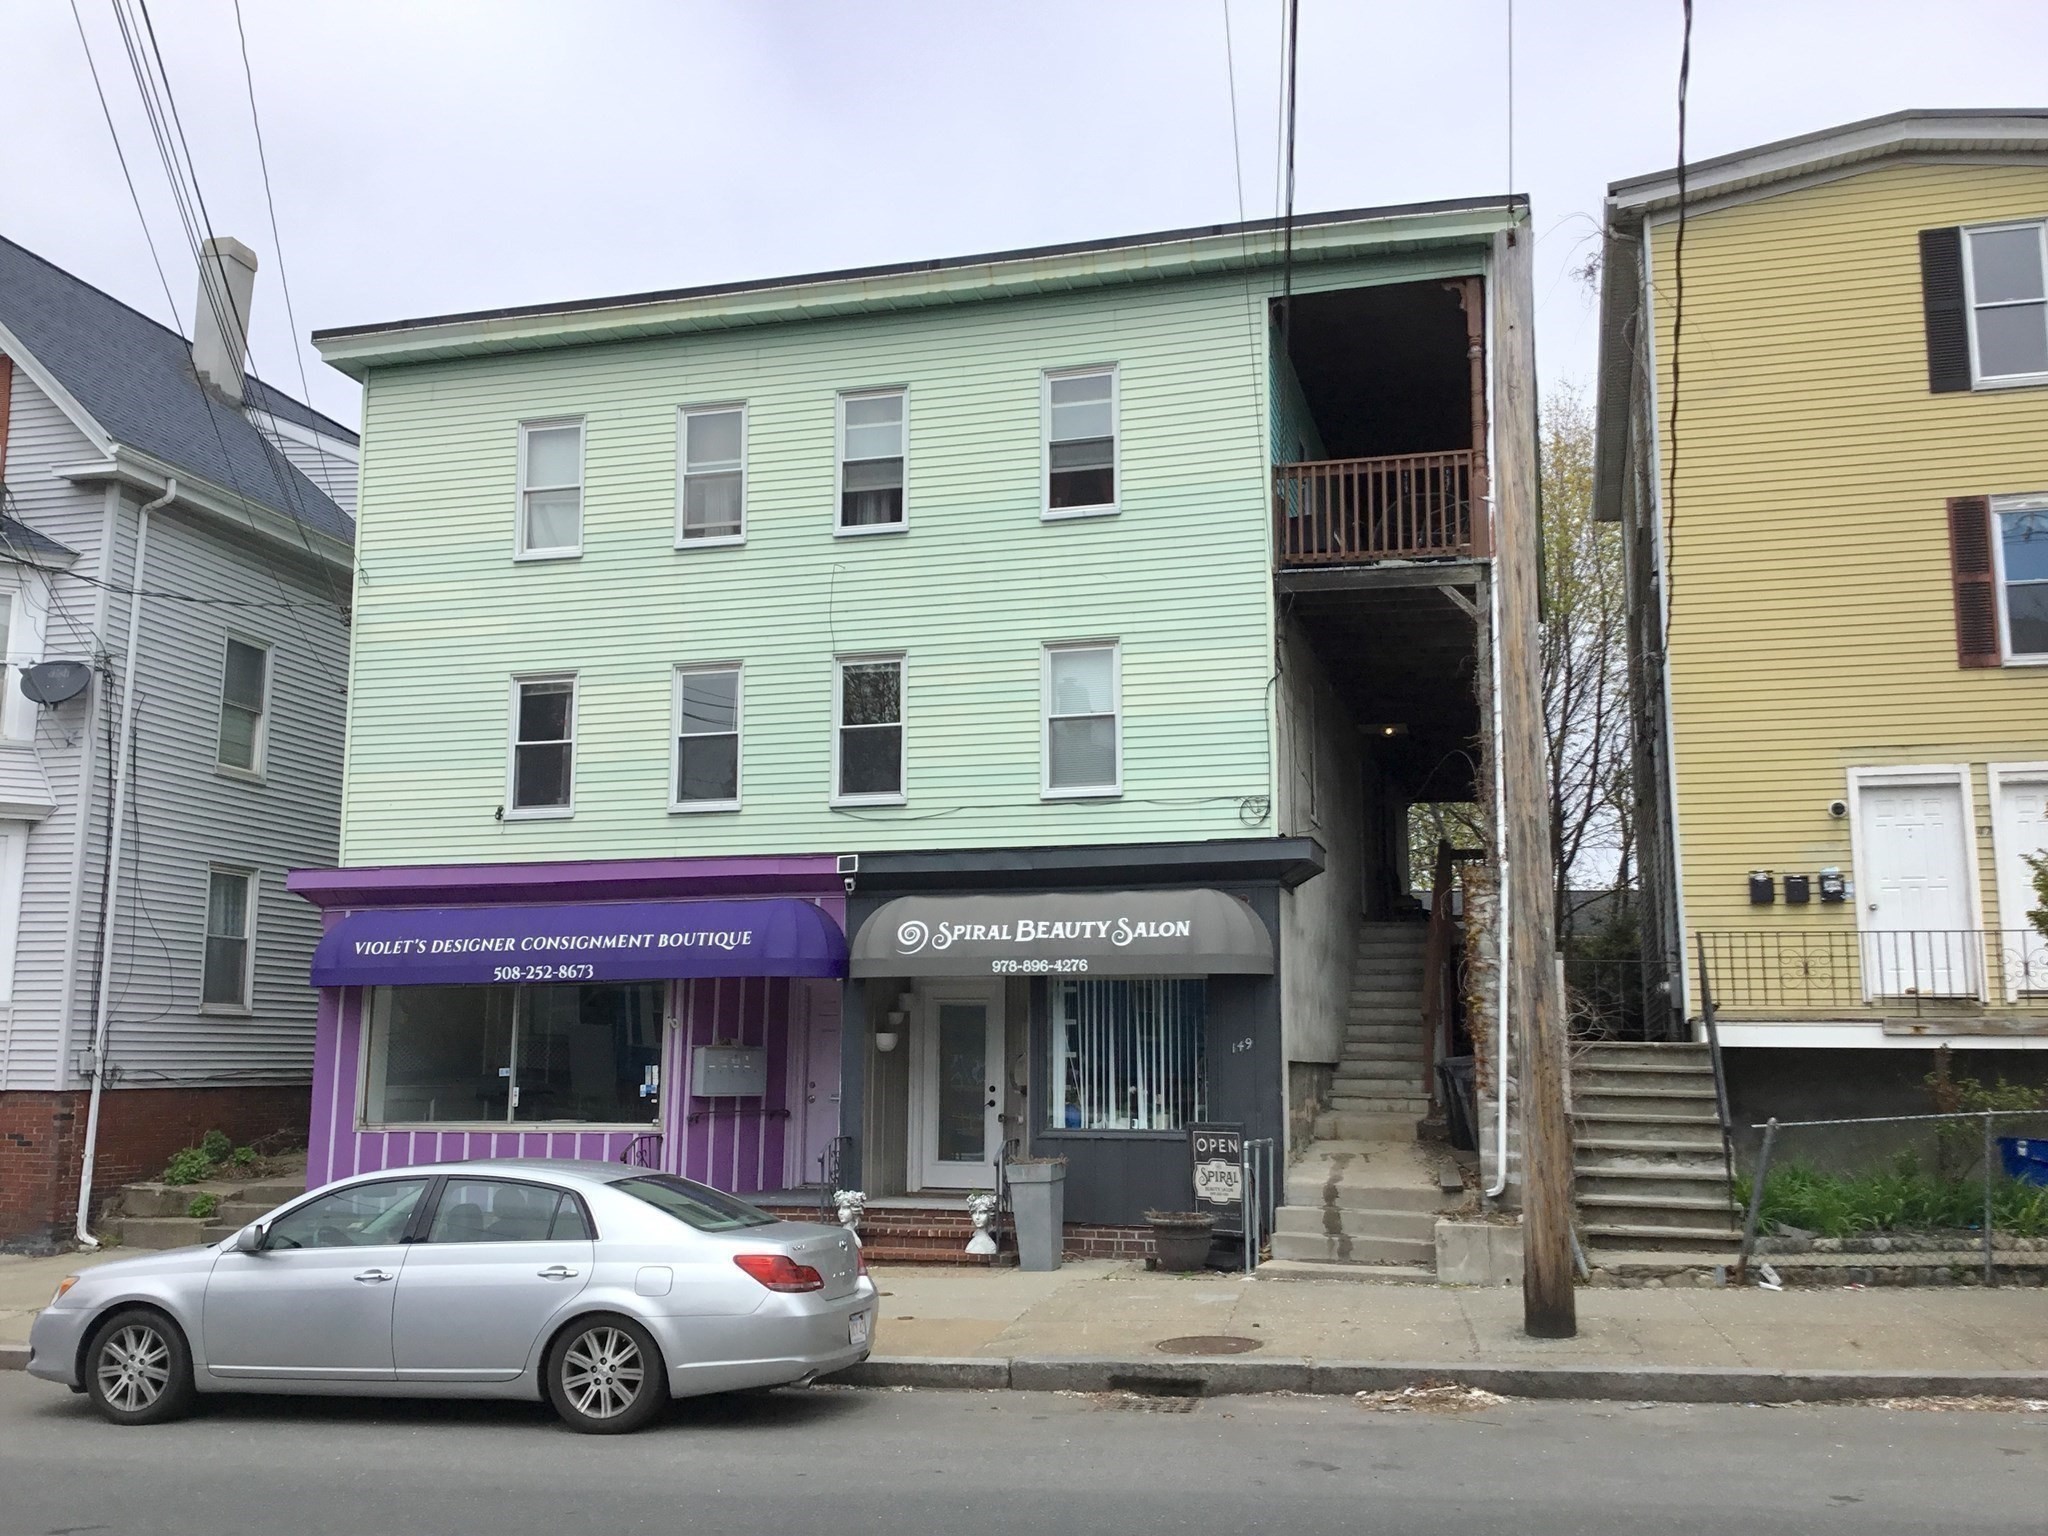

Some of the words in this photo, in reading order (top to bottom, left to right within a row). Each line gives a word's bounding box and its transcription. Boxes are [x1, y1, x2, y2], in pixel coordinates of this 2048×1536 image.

[931, 921, 1012, 950] SPIRAL
[1014, 919, 1112, 942] BEAUTY
[1111, 917, 1191, 947] SALON
[355, 938, 427, 955] VIOLET'S
[430, 937, 516, 954] DESIGNER
[520, 933, 654, 951] CONSIGNMENT
[657, 930, 753, 951] BOUTIQUE
[493, 964, 594, 981] 508-252-8673
[991, 959, 1089, 973] 978-896-4276
[1231, 1037, 1253, 1054] 149
[1196, 1137, 1239, 1154] OPEN
[1198, 1166, 1240, 1187] SPIRAL
